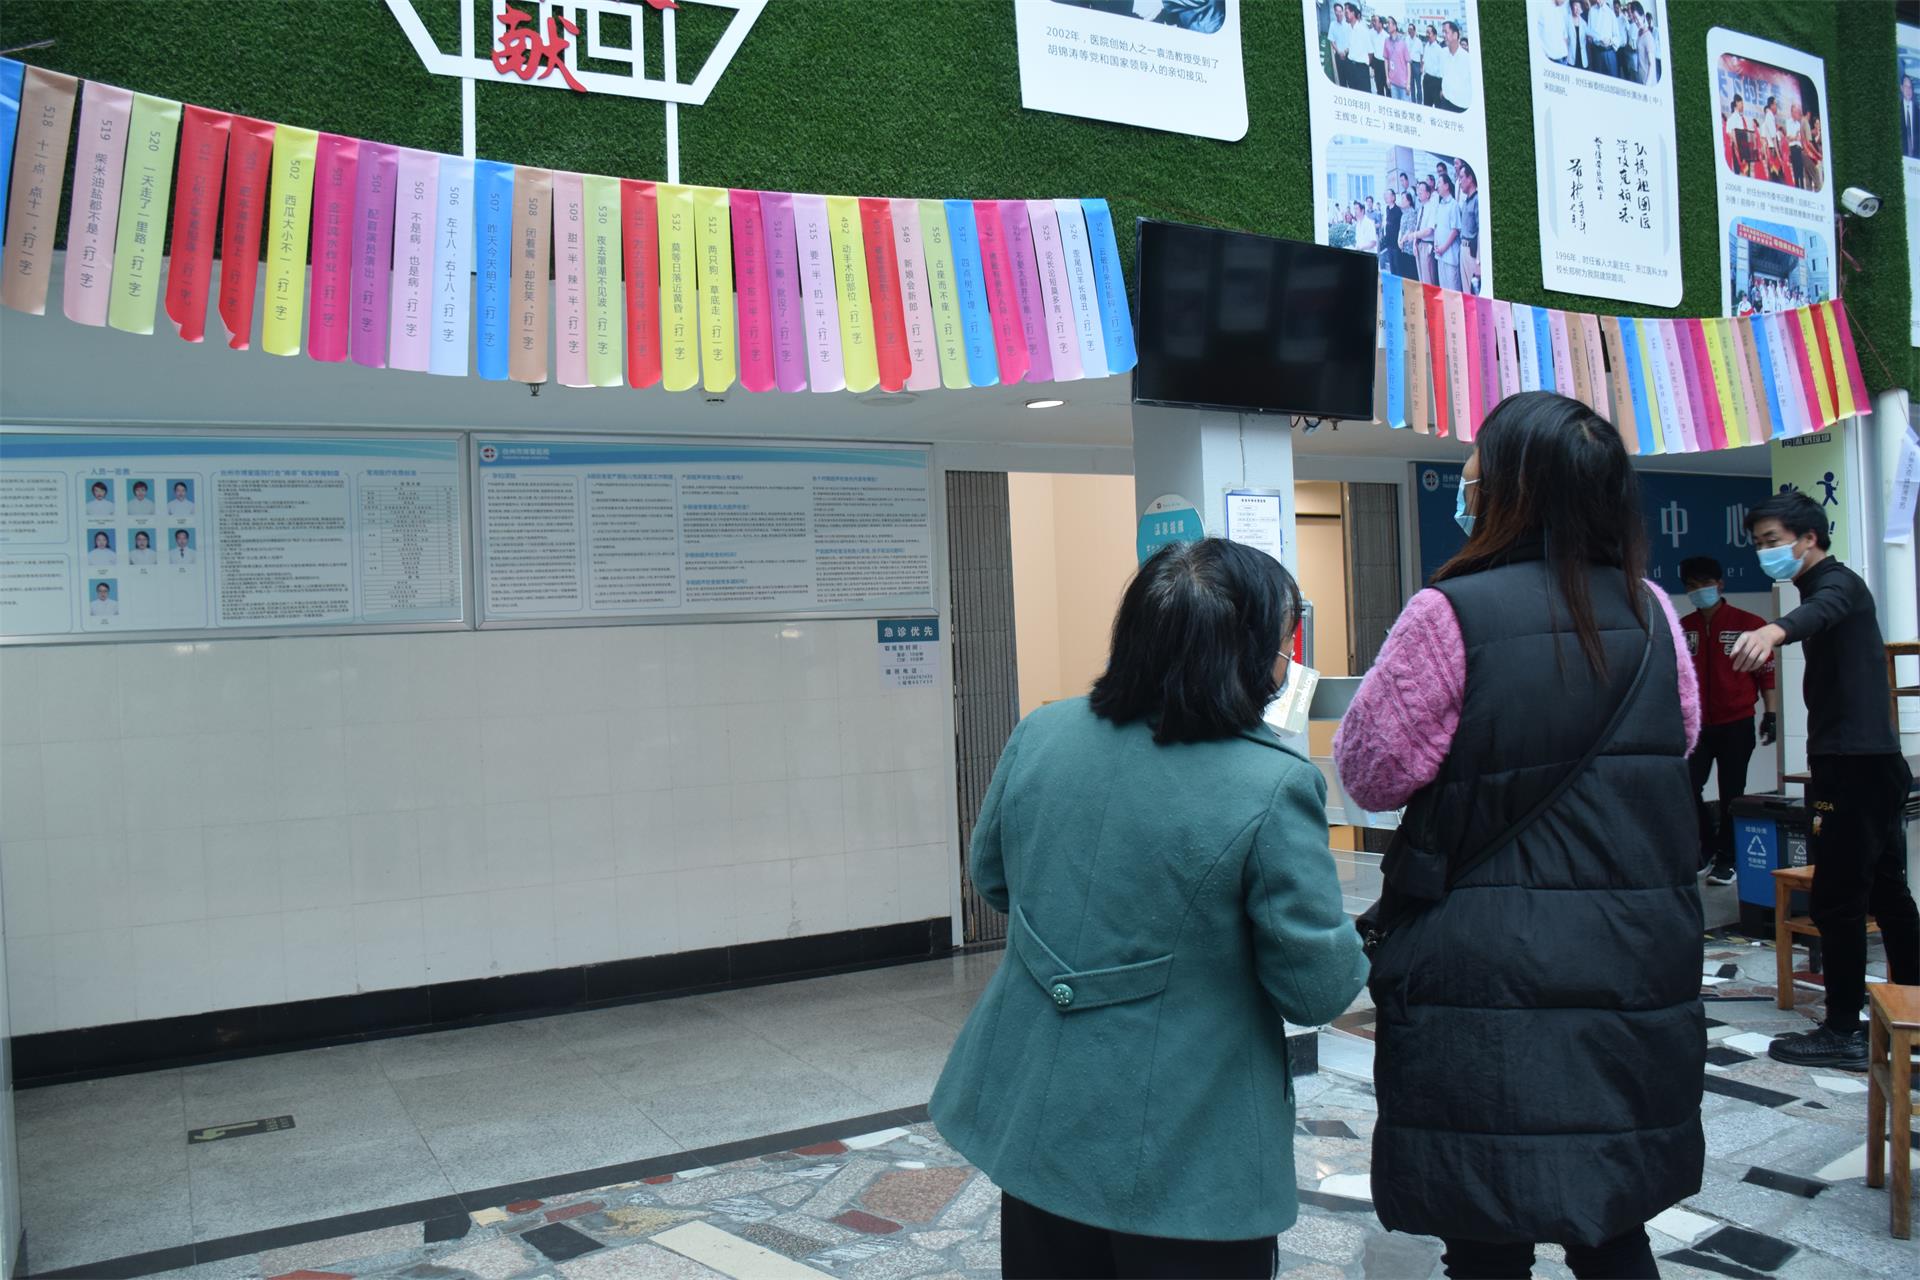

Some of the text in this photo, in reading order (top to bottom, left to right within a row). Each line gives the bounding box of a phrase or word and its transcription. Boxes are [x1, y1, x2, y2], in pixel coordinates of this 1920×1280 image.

[1047, 44, 1208, 84] 胡锦涛等党和国家领导人的亲切接见。
[41, 104, 56, 127] 518
[79, 118, 113, 289] 519 柴米油盐都不是。（打一字）
[490, 193, 500, 212] 507
[528, 197, 539, 216] 508
[129, 130, 161, 297] 520 一天走了一里路。（打一字）
[598, 206, 608, 224] 530
[671, 213, 681, 231] 532
[707, 217, 717, 234] 512
[808, 222, 818, 240] 515
[841, 216, 850, 234] 492
[1042, 225, 1051, 241] 525
[1069, 223, 1078, 240] 526
[275, 159, 301, 321] 502 西瓜大小不一。（打一字）
[901, 226, 911, 243] 549
[931, 226, 941, 243] 550
[405, 181, 425, 338] 505 不是病，也是病。（打一字）
[442, 186, 459, 343] 506 左十八，右十八。（打一字）
[566, 203, 579, 354] 509 甜一半，辣一半。（打一字）
[884, 625, 933, 637] 急诊优先
